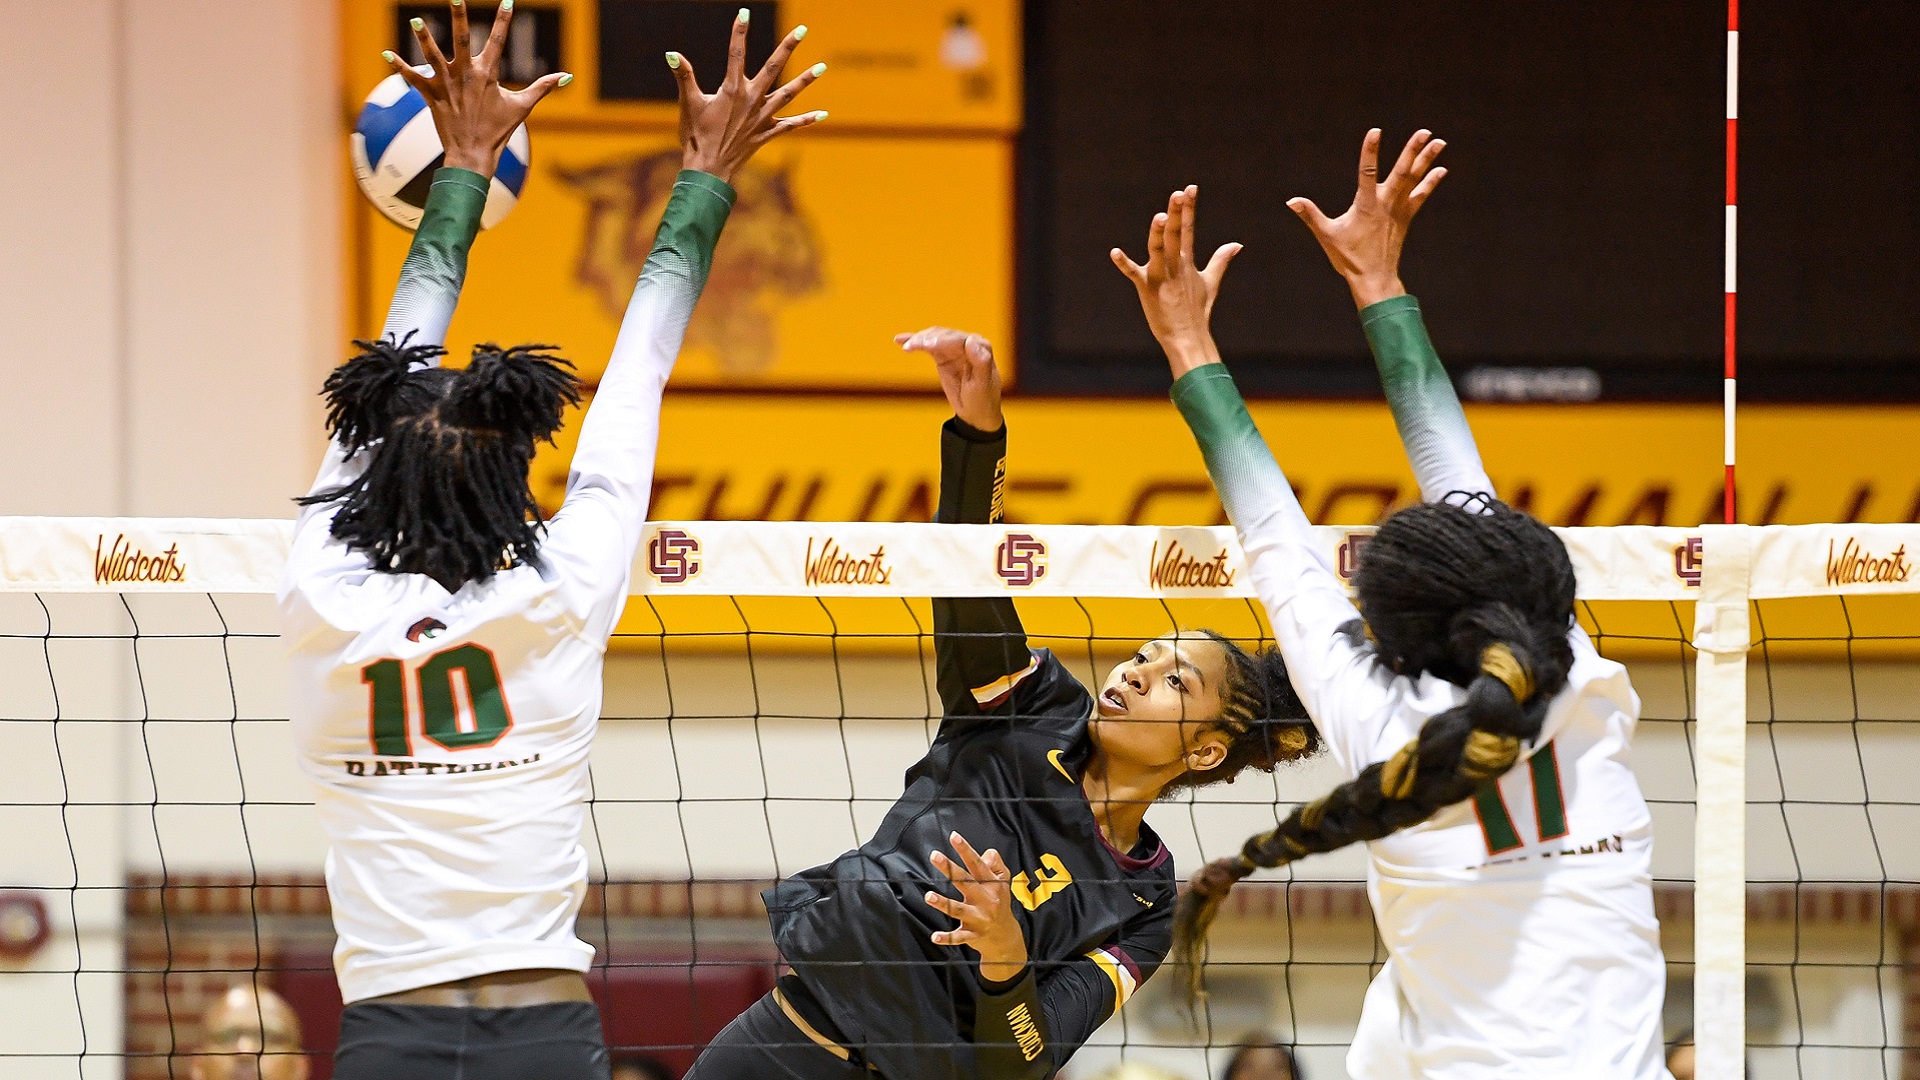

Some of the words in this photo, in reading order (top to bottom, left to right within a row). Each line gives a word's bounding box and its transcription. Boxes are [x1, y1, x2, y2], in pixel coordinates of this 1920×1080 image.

[988, 454, 1007, 525] BETHUNE
[94, 533, 186, 585] Wildcats
[804, 536, 892, 588] Wildcats
[1149, 539, 1235, 591] Wildcats
[1826, 536, 1912, 587] Wildcats
[360, 641, 516, 758] 10
[1010, 852, 1073, 912] 3
[1005, 1001, 1045, 1062] COOKMAN
